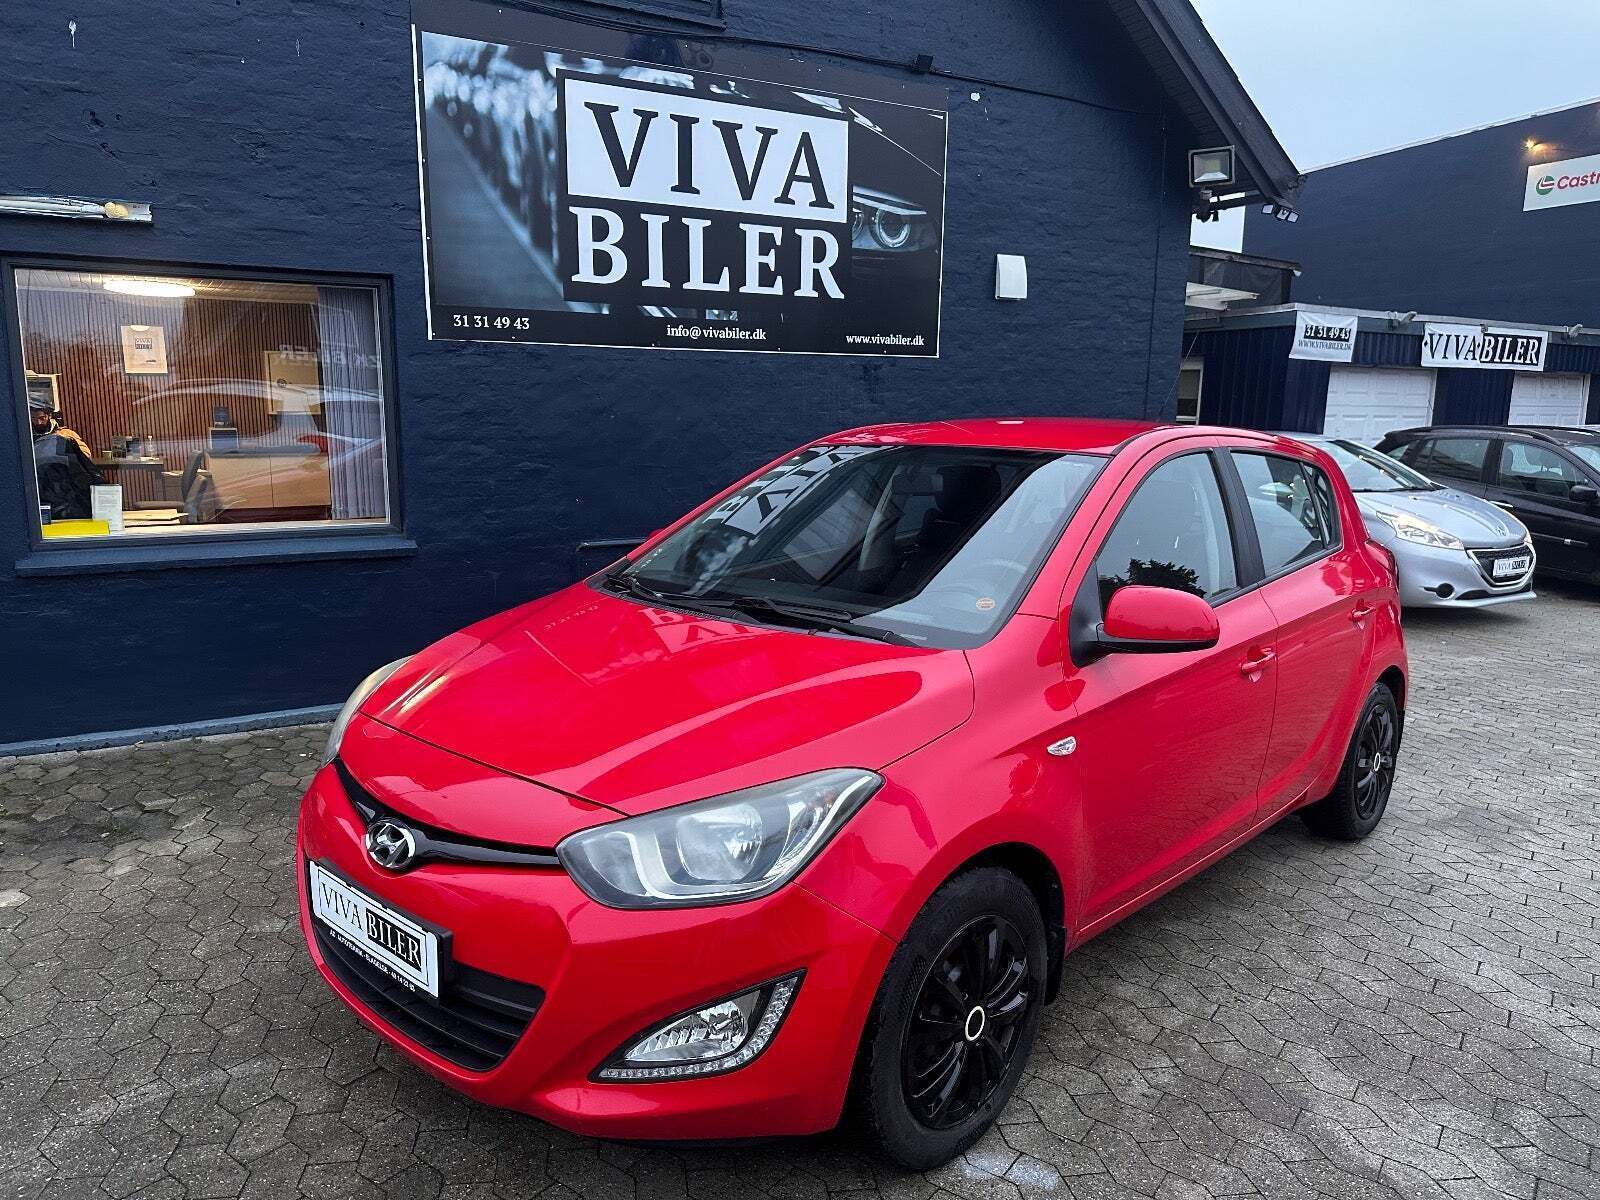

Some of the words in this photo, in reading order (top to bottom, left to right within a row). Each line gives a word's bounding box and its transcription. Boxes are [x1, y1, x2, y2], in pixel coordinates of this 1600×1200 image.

[583, 101, 835, 210] VIVA
[568, 205, 845, 299] BILER
[453, 314, 470, 327] 31
[474, 315, 490, 328] 31
[493, 316, 511, 329] 49
[513, 317, 530, 330] 43
[666, 325, 767, 340] info@vivabiler.dk
[1305, 325, 1316, 337] 31
[1317, 326, 1327, 338] 31
[1328, 327, 1340, 339] 49
[1340, 328, 1350, 340] 43
[846, 334, 924, 346] www.vivabiler.dk
[1428, 333, 1478, 361] VIVA
[1480, 335, 1540, 364] BILER
[321, 882, 364, 932] VIVA
[367, 911, 422, 968] BILER
